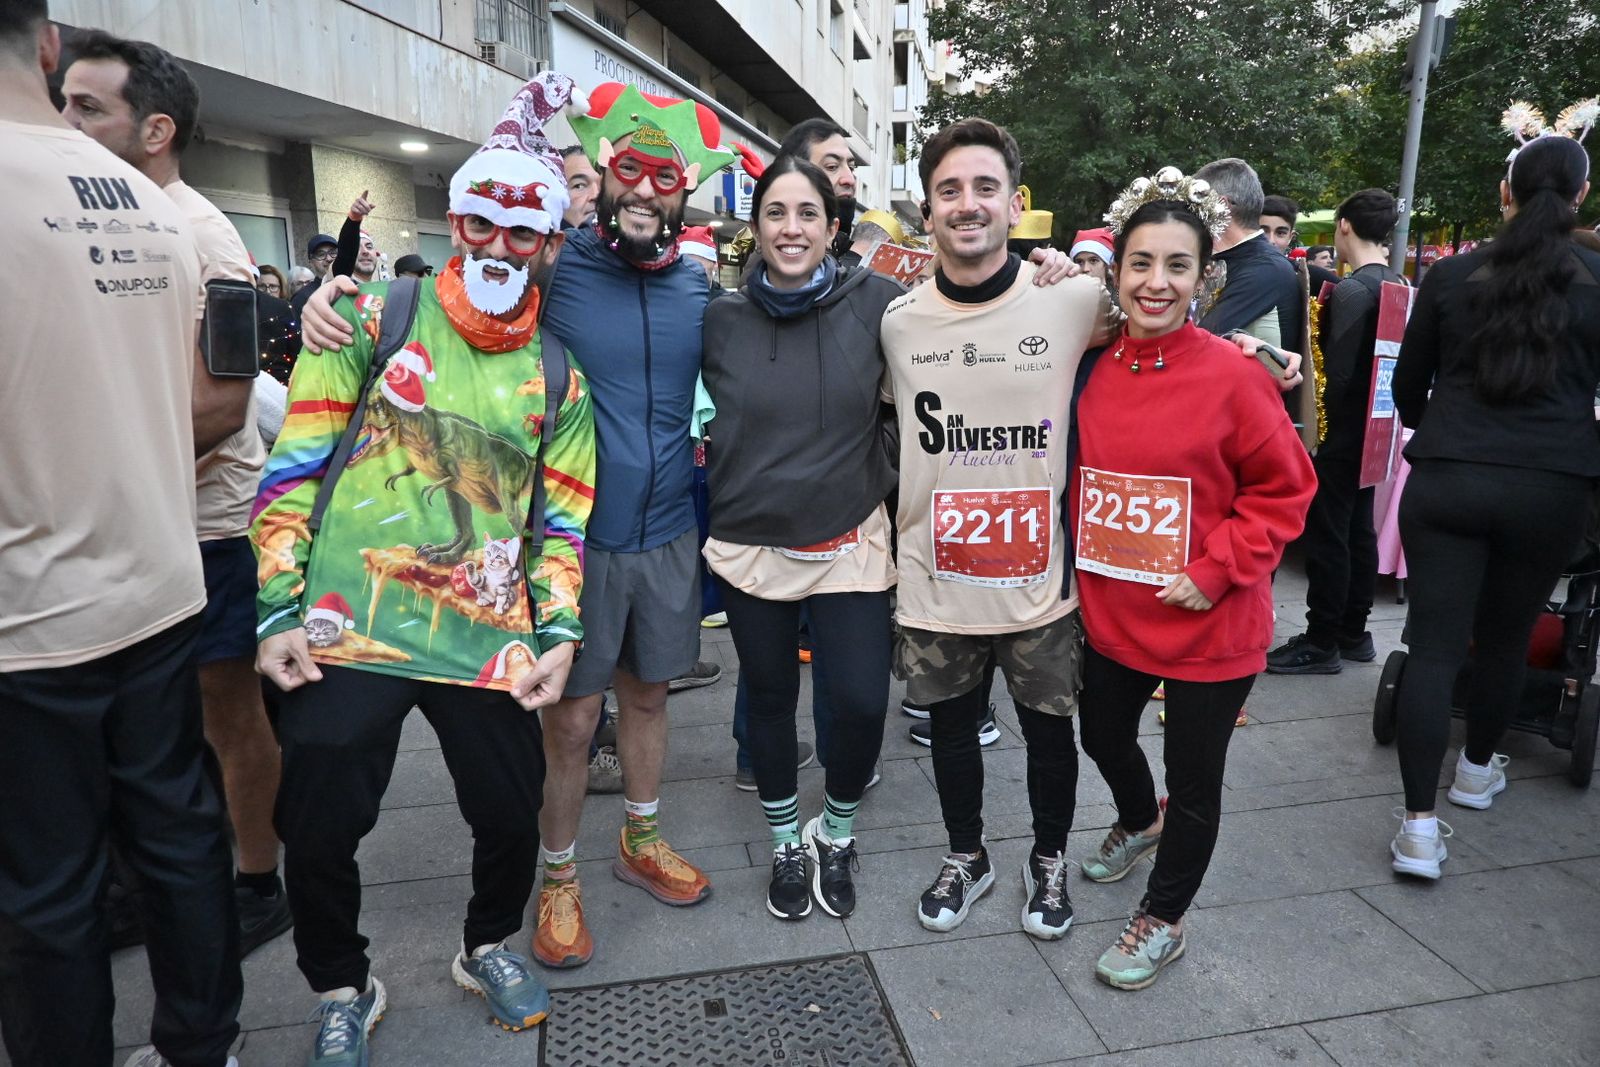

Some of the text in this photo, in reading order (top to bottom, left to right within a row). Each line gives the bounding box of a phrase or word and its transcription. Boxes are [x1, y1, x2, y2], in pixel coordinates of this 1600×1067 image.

[67, 175, 140, 210] RUN
[911, 351, 950, 366] Huelva
[1014, 361, 1053, 373] HUELVA
[949, 438, 1018, 467] Huelva
[940, 508, 1037, 544] 2211
[1084, 487, 1181, 536] 2252
